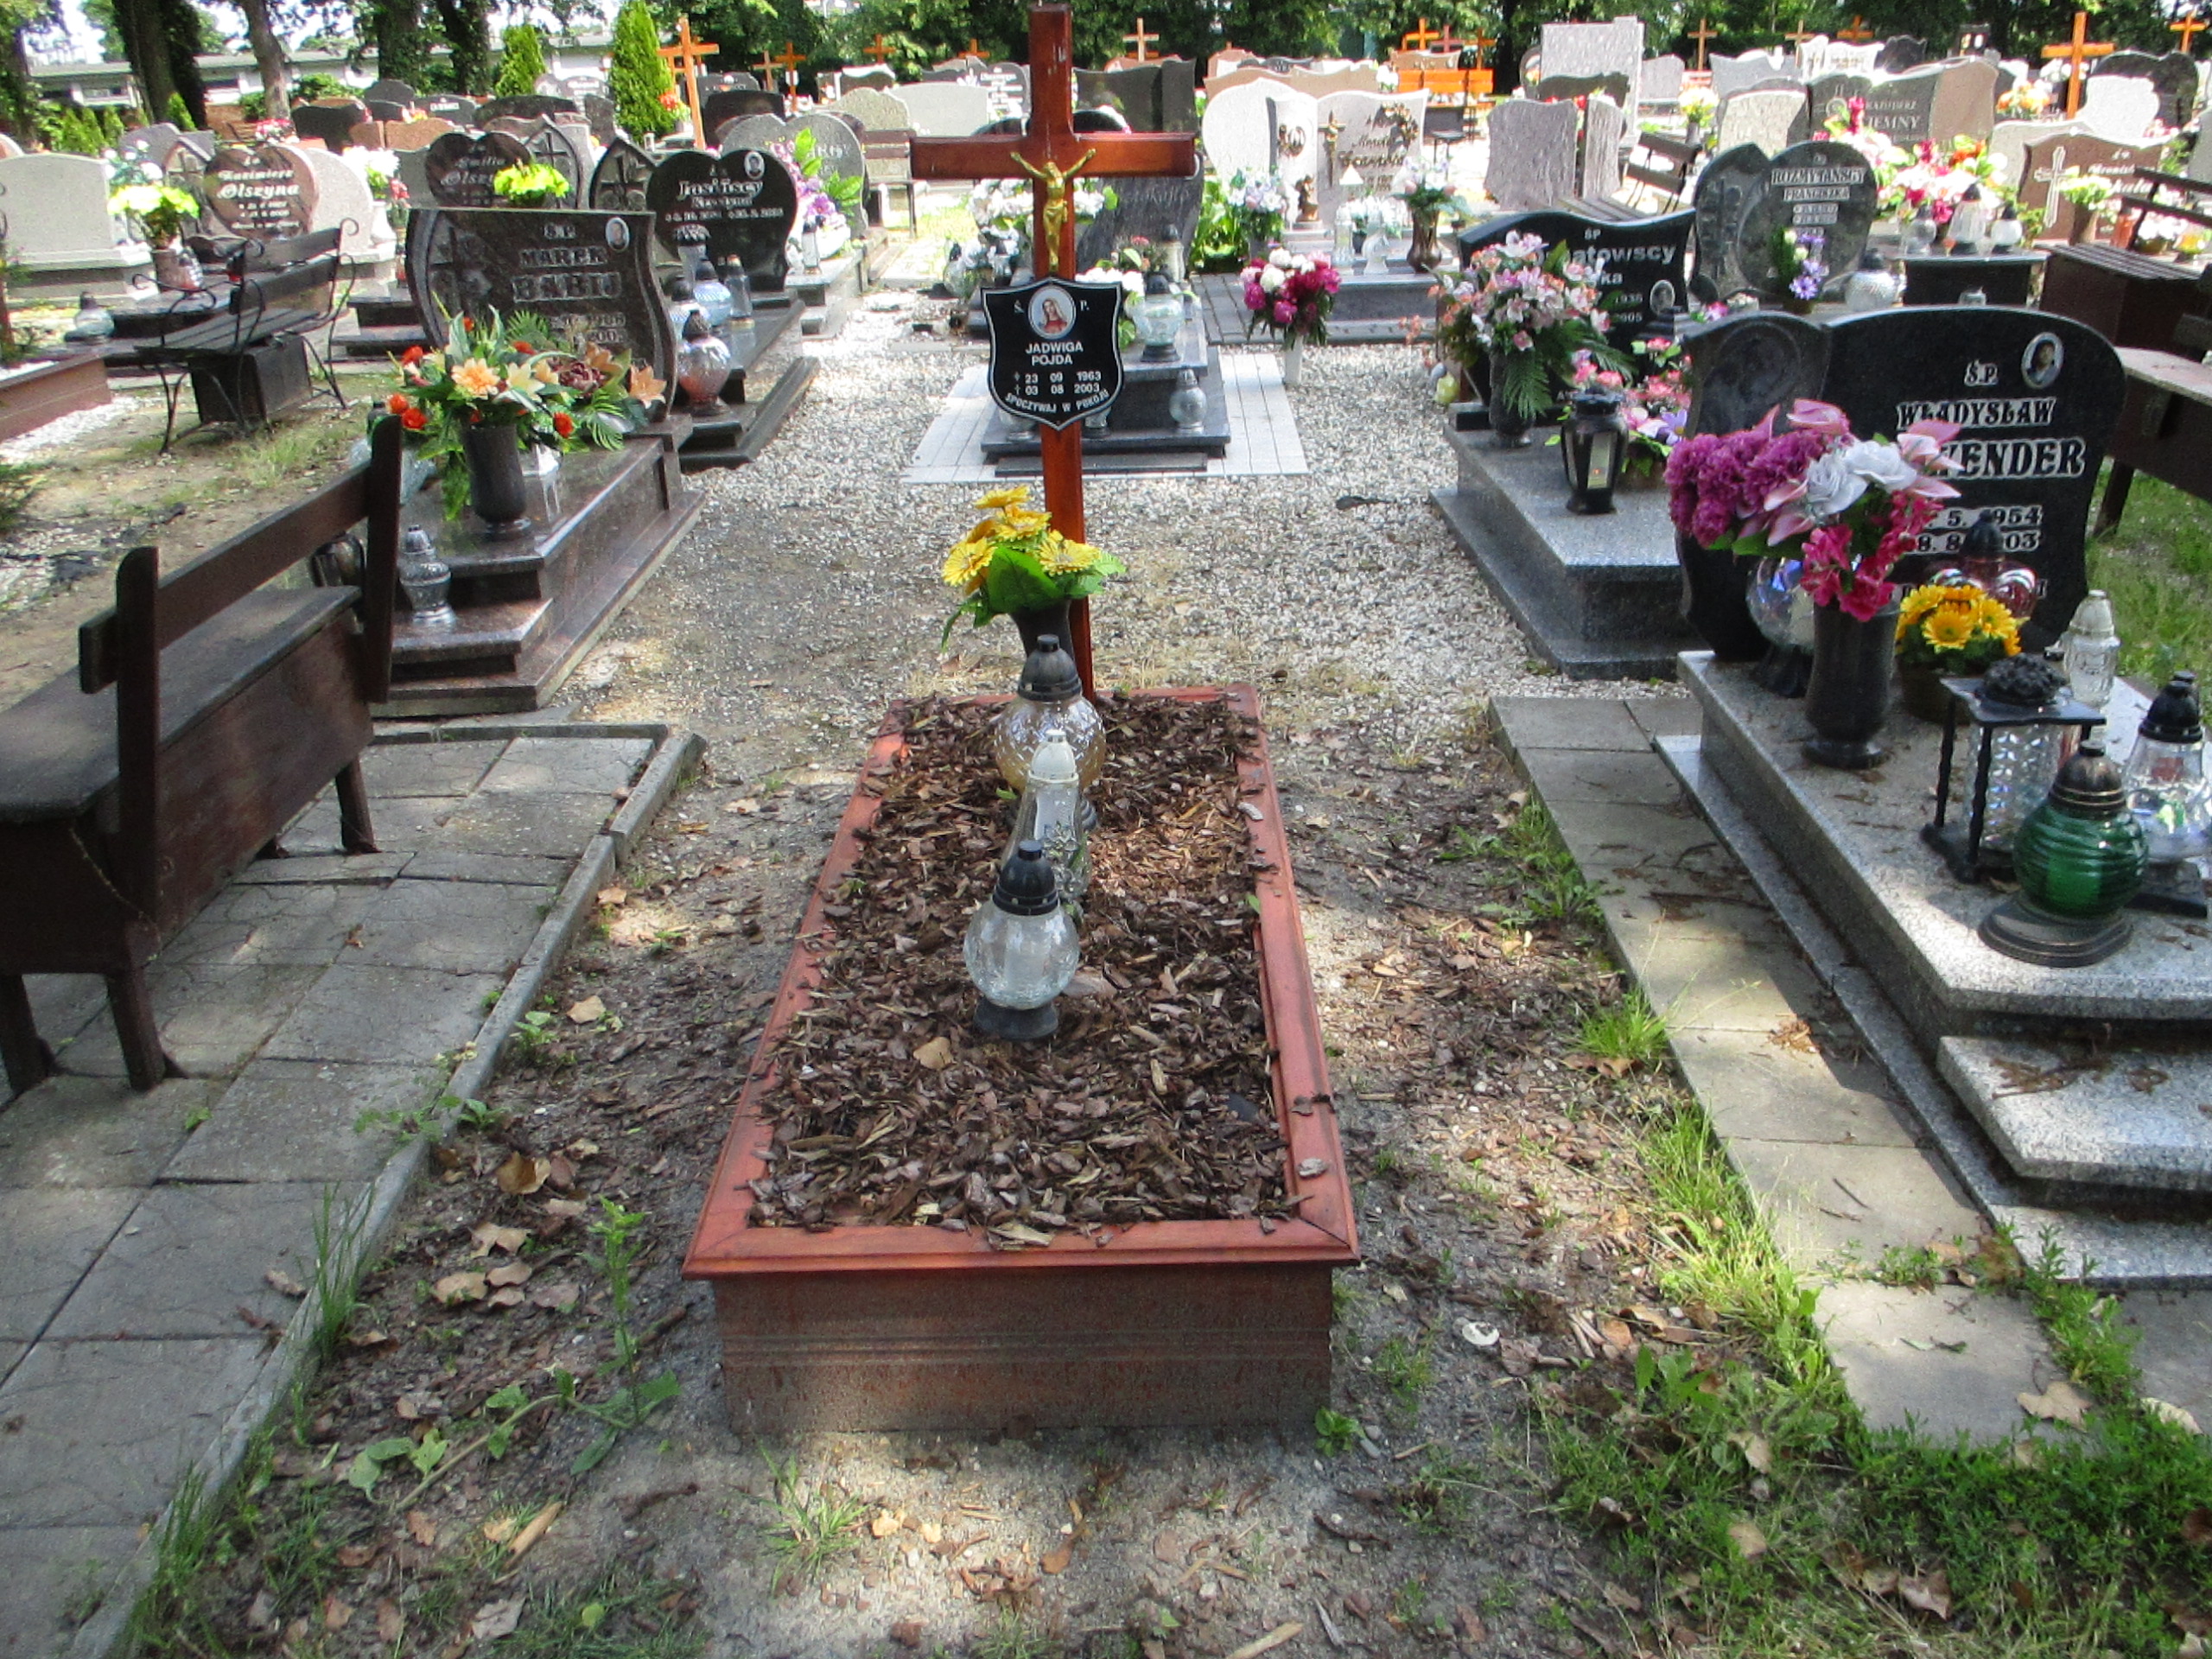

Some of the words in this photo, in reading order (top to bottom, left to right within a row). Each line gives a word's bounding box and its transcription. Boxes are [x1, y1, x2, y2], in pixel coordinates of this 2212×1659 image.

[1866, 114, 1921, 129] IEMNY
[217, 183, 301, 200] Olszyna
[1025, 341, 1084, 354] JADWIGA
[1032, 354, 1073, 366] POJDA
[1025, 373, 1039, 384] 23
[1050, 372, 1064, 383] 09
[1076, 371, 1102, 382] 1963
[1025, 385, 1039, 396] 03
[1051, 384, 1065, 395] 08
[1074, 382, 1100, 394] 2003
[1005, 392, 1058, 413] SPOCZYWAJ
[1062, 402, 1071, 412] W
[1076, 389, 1110, 410] POKOJU
[1896, 396, 2057, 430] WŁADYSŁAW
[1980, 505, 2043, 527] 954
